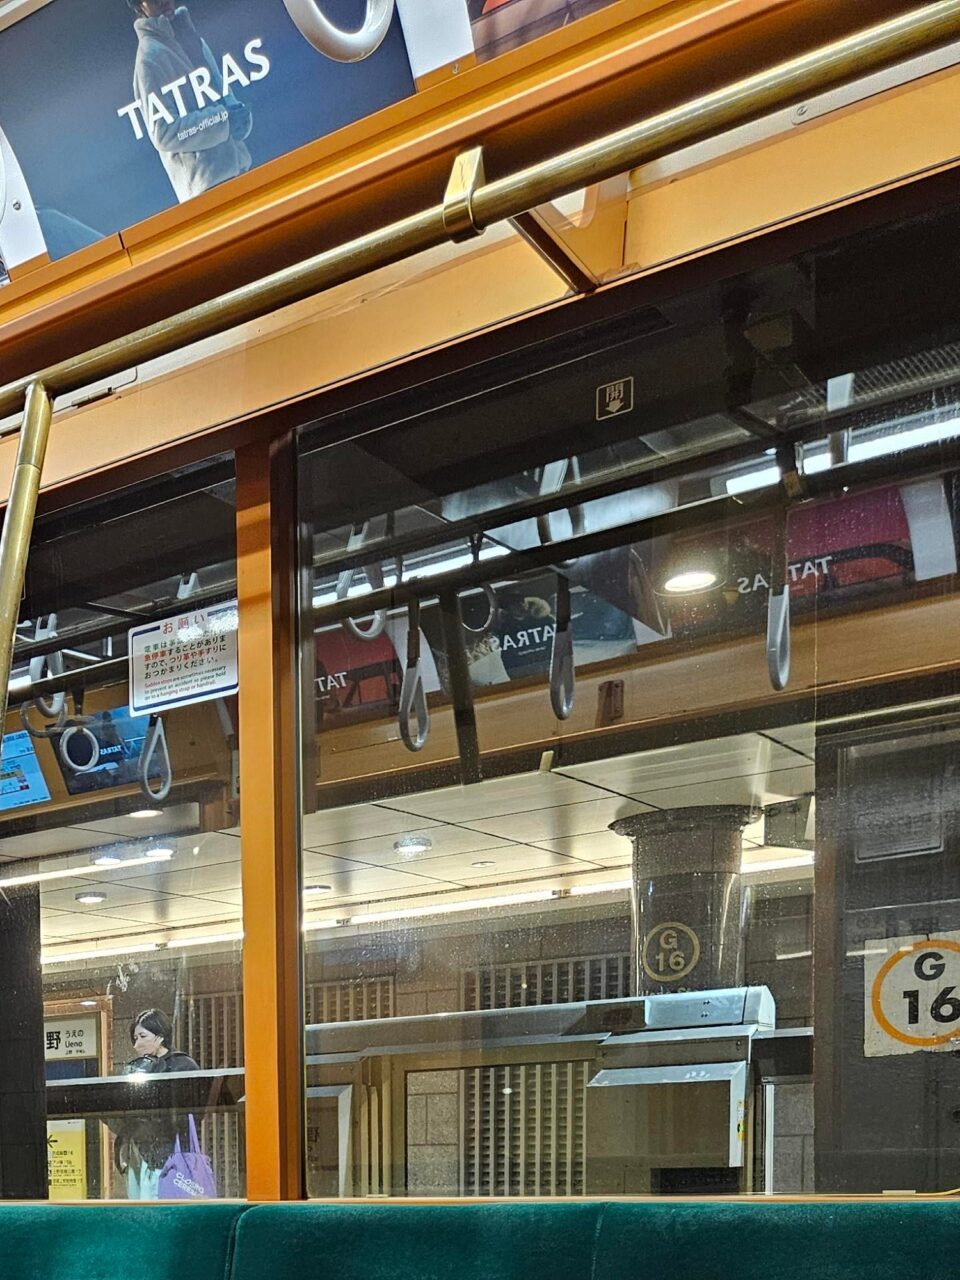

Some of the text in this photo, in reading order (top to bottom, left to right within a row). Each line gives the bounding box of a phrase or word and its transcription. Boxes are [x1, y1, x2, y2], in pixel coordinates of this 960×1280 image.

[117, 37, 270, 140] TATRAS
[177, 110, 229, 141] tatras-official.jp
[606, 383, 624, 403] 開
[660, 929, 678, 949] G
[656, 950, 685, 971] 16
[914, 951, 946, 981] G
[903, 986, 960, 1025] 16
[65, 1030, 84, 1038] うえの
